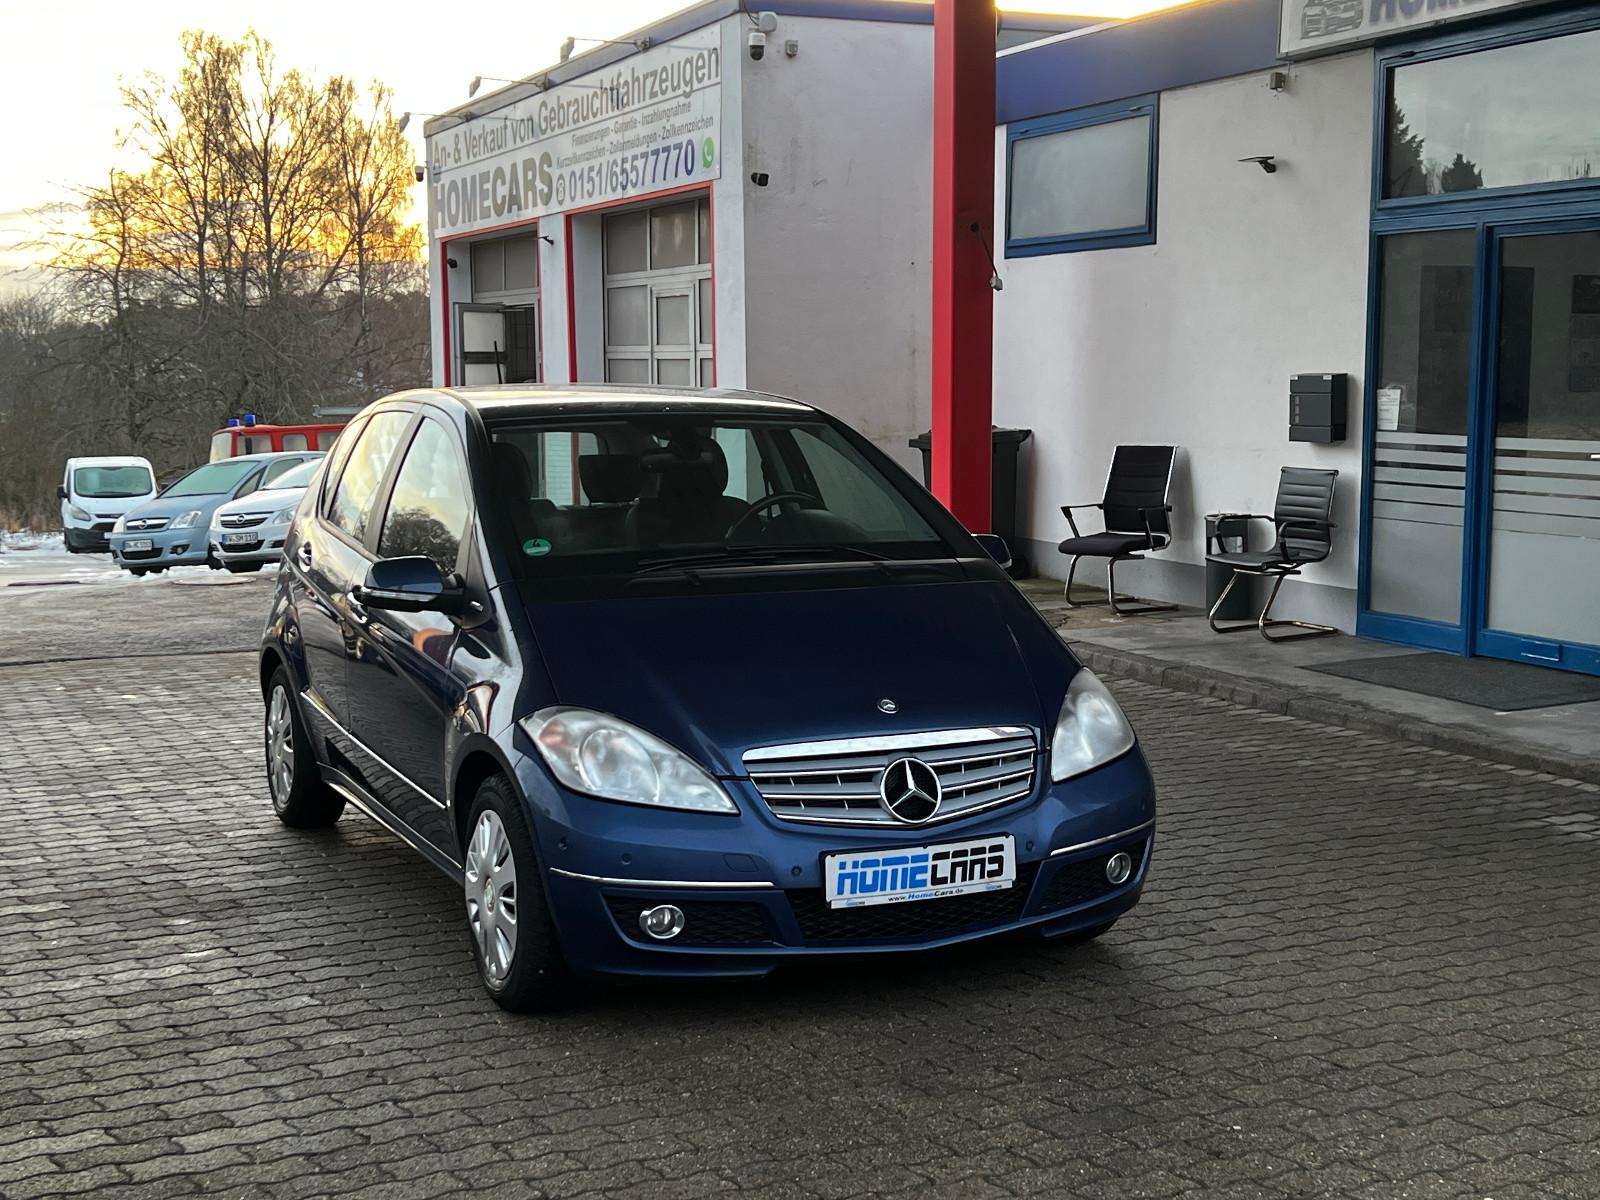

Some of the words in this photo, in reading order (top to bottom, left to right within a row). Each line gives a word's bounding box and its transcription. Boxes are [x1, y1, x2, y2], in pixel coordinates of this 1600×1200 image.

[453, 132, 462, 165] &
[464, 115, 508, 161] Verkauf
[511, 114, 534, 145] von
[538, 47, 720, 136] Gebrauchtfahrzeugen
[641, 101, 692, 126] Inzahlungnahme
[662, 115, 714, 141] Zollkennzeichen
[433, 151, 553, 230] HOMECARS
[568, 138, 696, 202] 0151/65577770
[837, 844, 1005, 896] HOMECARS
